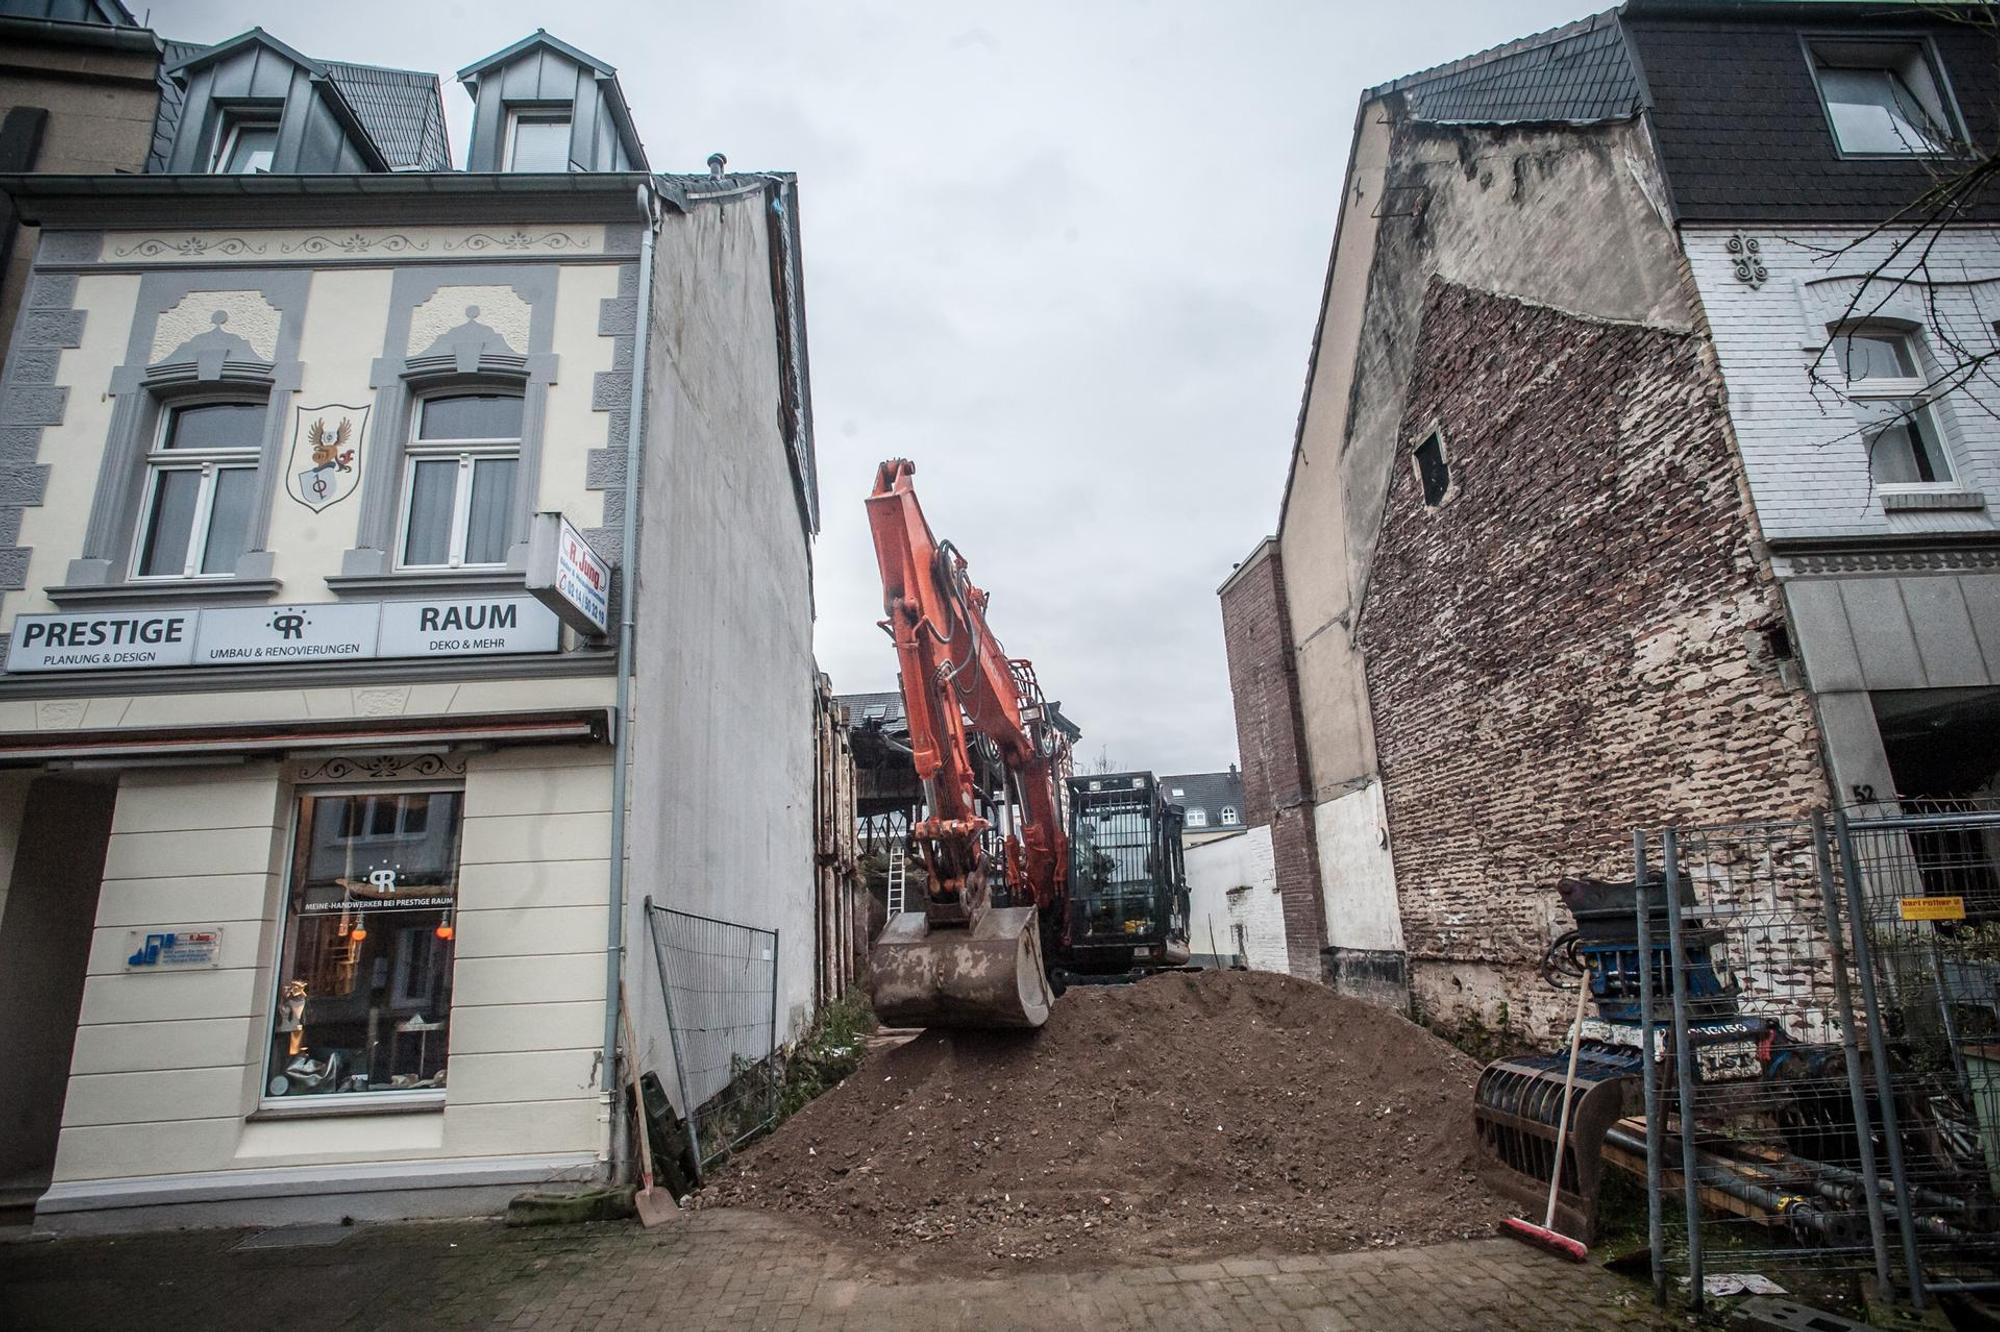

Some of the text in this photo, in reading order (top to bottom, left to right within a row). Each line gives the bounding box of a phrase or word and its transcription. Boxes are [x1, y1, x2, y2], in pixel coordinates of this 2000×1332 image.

[579, 550, 600, 590] Jung
[420, 604, 517, 632] RAUM
[22, 618, 185, 648] PRESTIGE
[210, 643, 360, 659] UMBAU & RENOVIERUNGEN
[429, 638, 505, 651] DEKO & MEHR
[43, 652, 156, 665] PLANUNG & DESIGN
[1853, 784, 1878, 802] 52
[305, 897, 453, 910] MEINE-HANDWERKER BEI PRESTIGE RAUM
